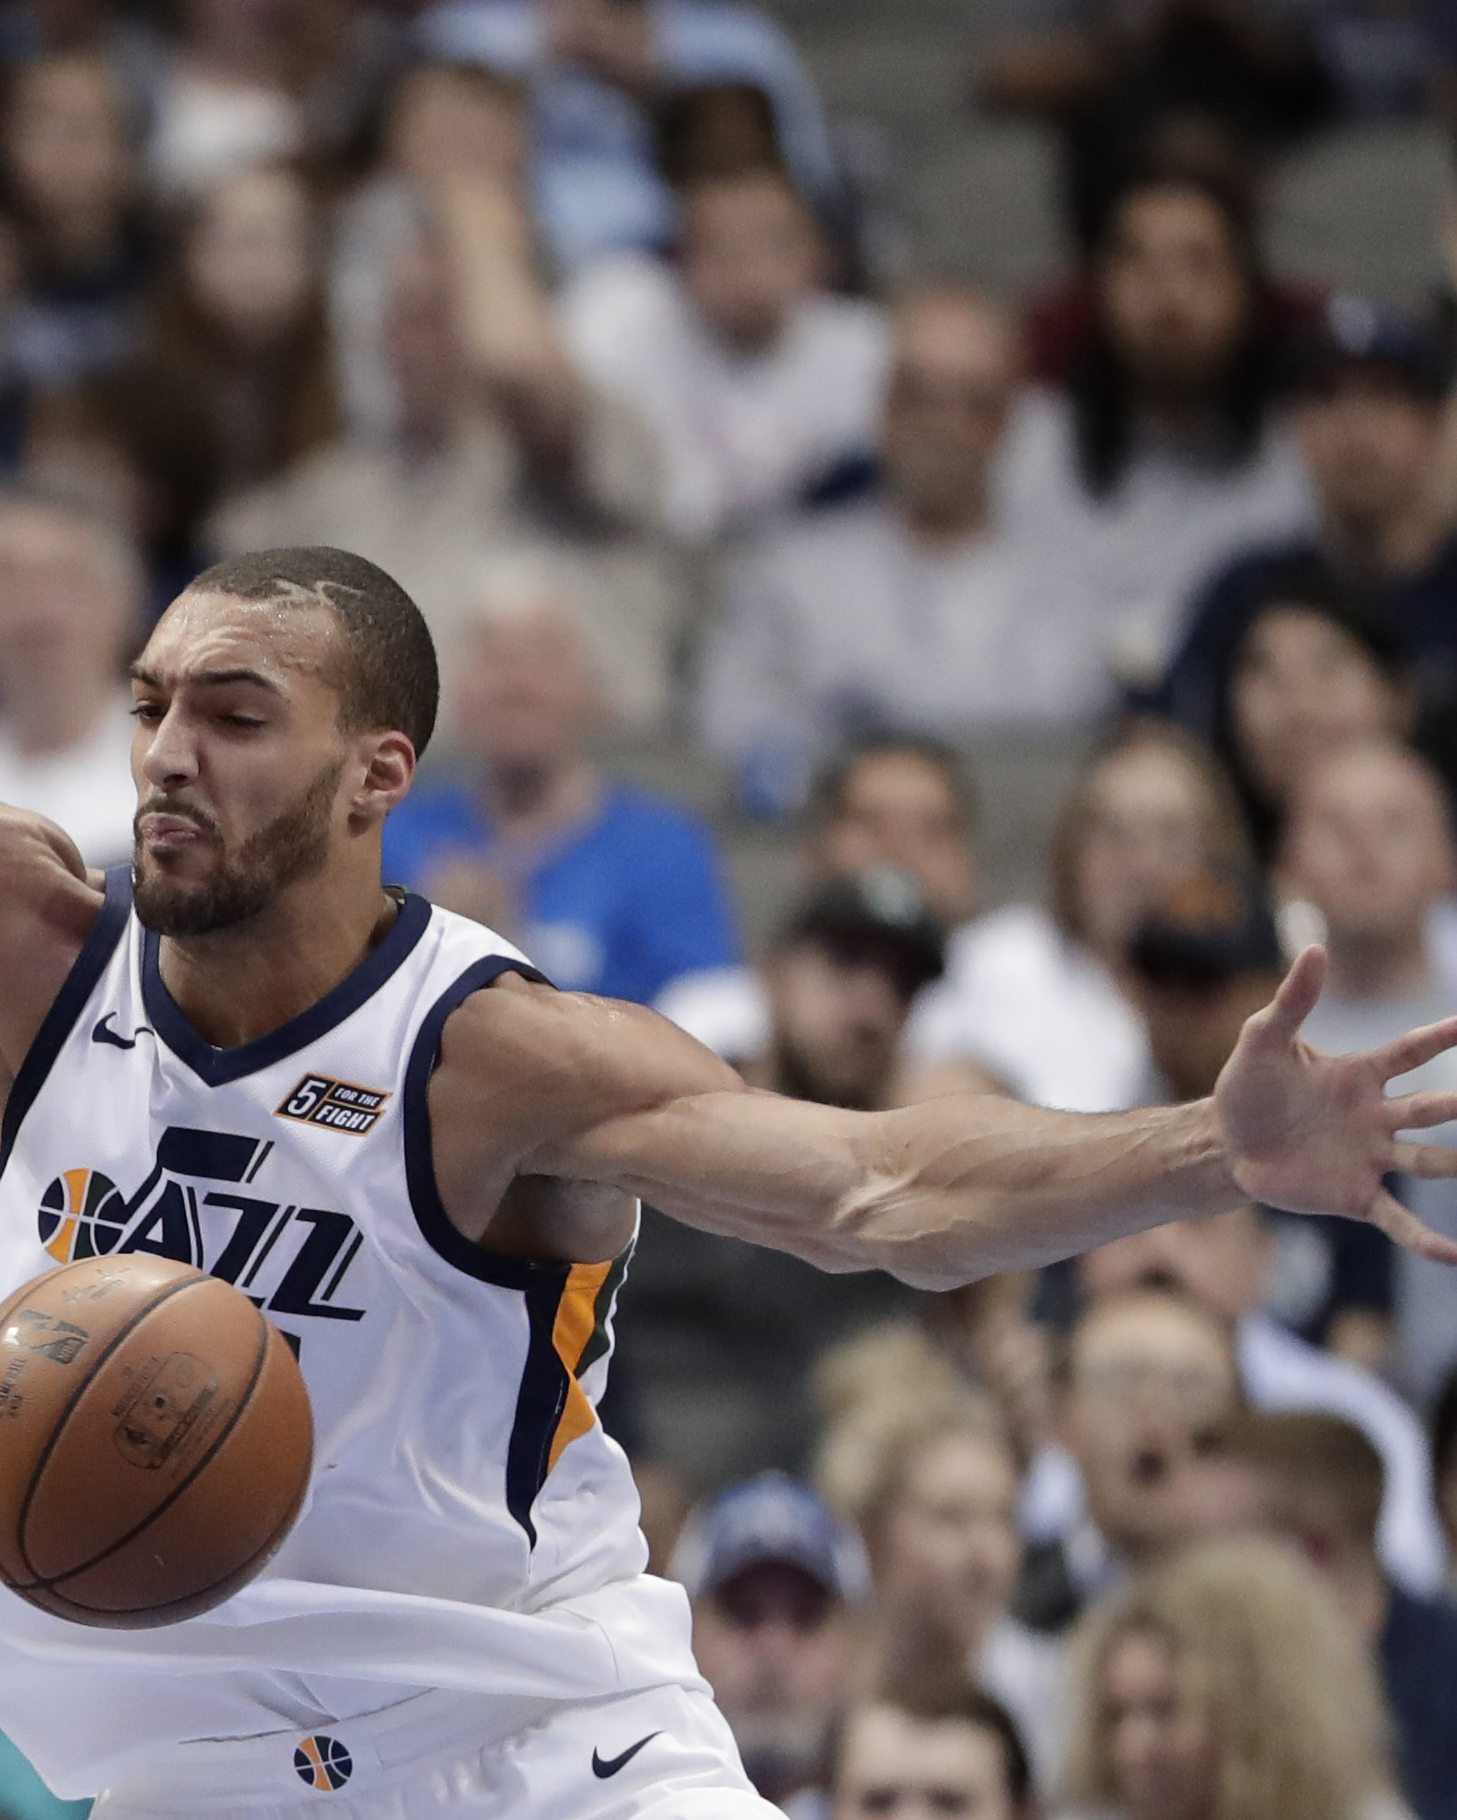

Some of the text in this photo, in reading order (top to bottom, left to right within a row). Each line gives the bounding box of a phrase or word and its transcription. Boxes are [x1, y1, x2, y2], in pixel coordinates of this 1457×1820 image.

[287, 1079, 327, 1115] 5
[334, 1087, 381, 1107] FOR THE
[315, 1105, 376, 1131] FIGHT
